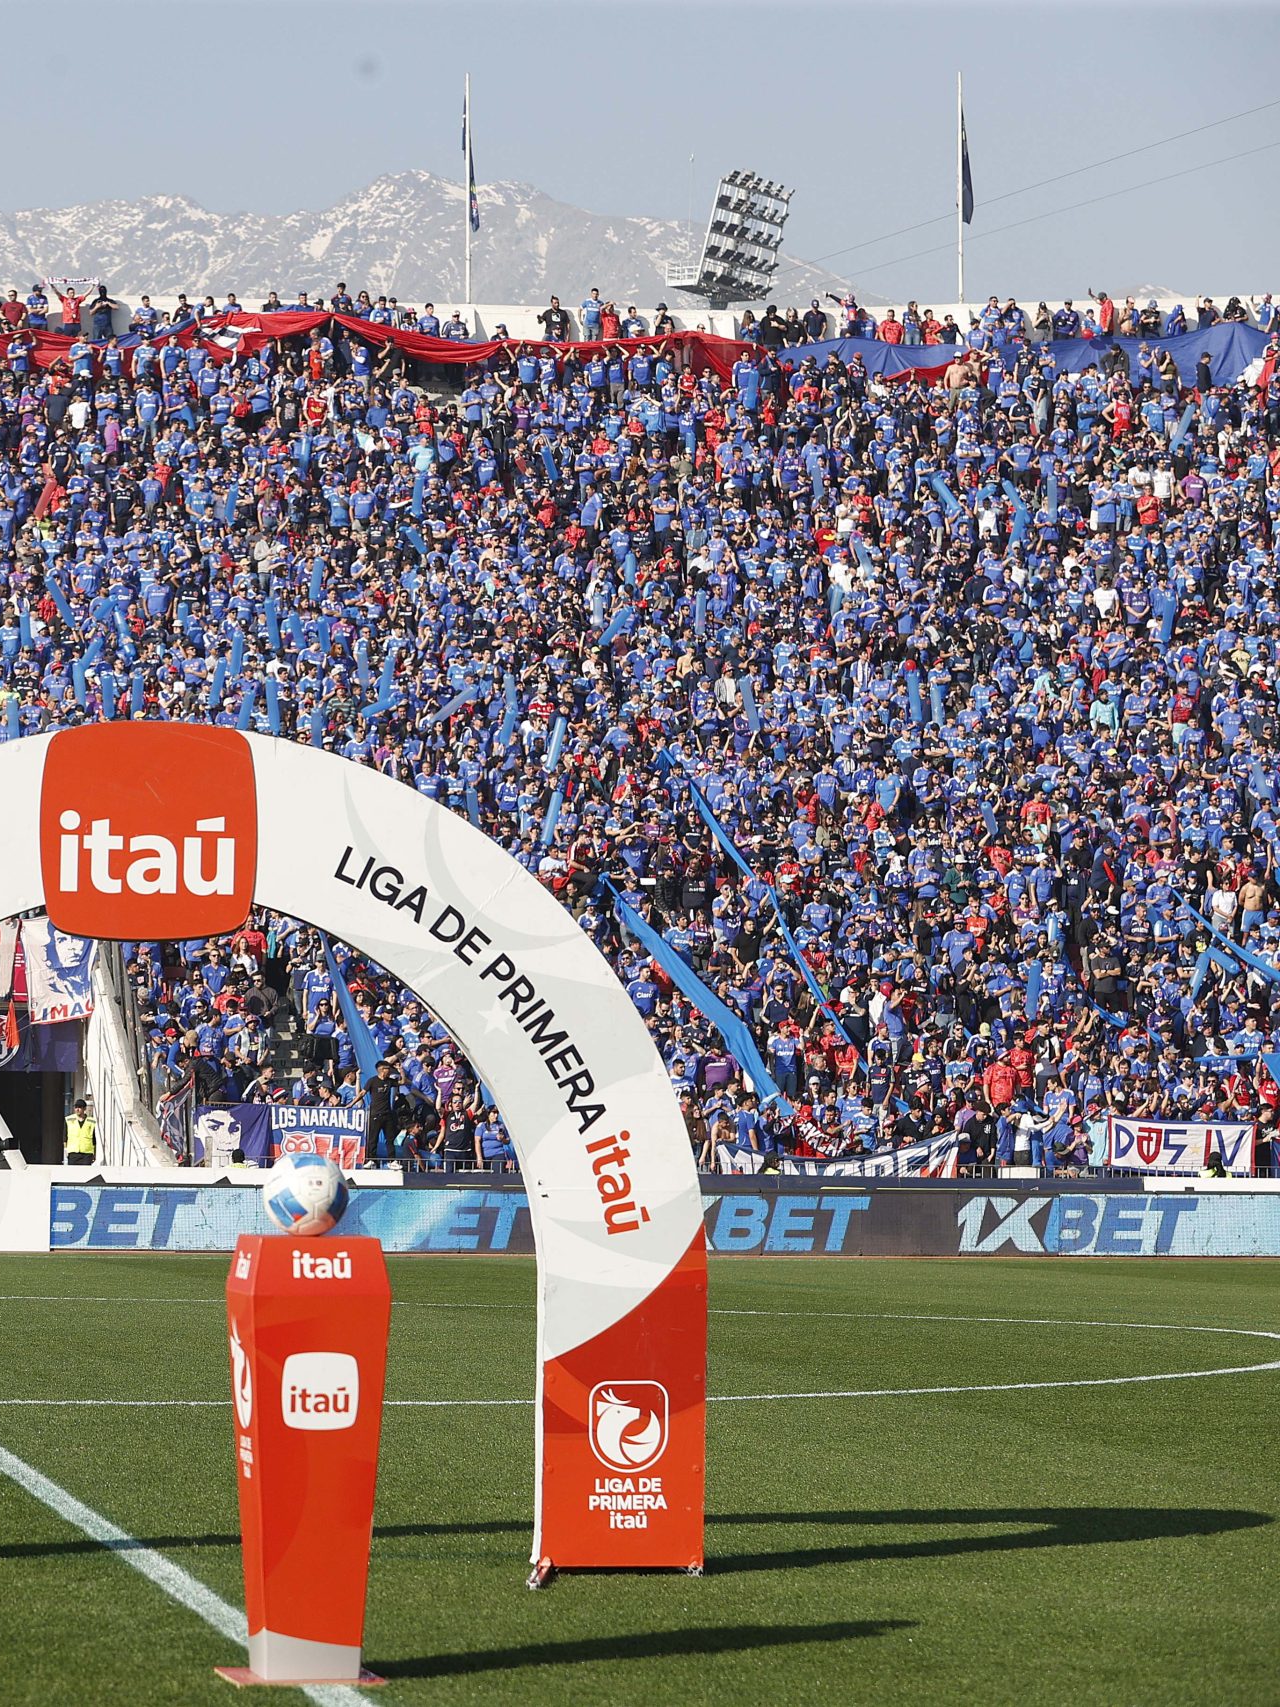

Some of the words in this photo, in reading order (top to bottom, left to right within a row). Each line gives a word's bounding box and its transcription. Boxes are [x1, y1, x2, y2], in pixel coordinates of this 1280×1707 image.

[60, 809, 235, 896] itaú
[333, 845, 428, 923] LIGA
[429, 904, 491, 966] DE
[479, 953, 606, 1135] PRIMERA
[585, 1130, 651, 1235] itaú
[271, 1106, 297, 1127] LOS
[300, 1107, 365, 1132] NARANJO
[957, 1196, 1199, 1253] 1XBET
[292, 1250, 352, 1279] itaú
[290, 1386, 349, 1413] itaú
[595, 1478, 634, 1493] LIGA
[639, 1478, 661, 1492] DE
[588, 1495, 667, 1510] PRIMERA
[609, 1511, 647, 1528] itaú
